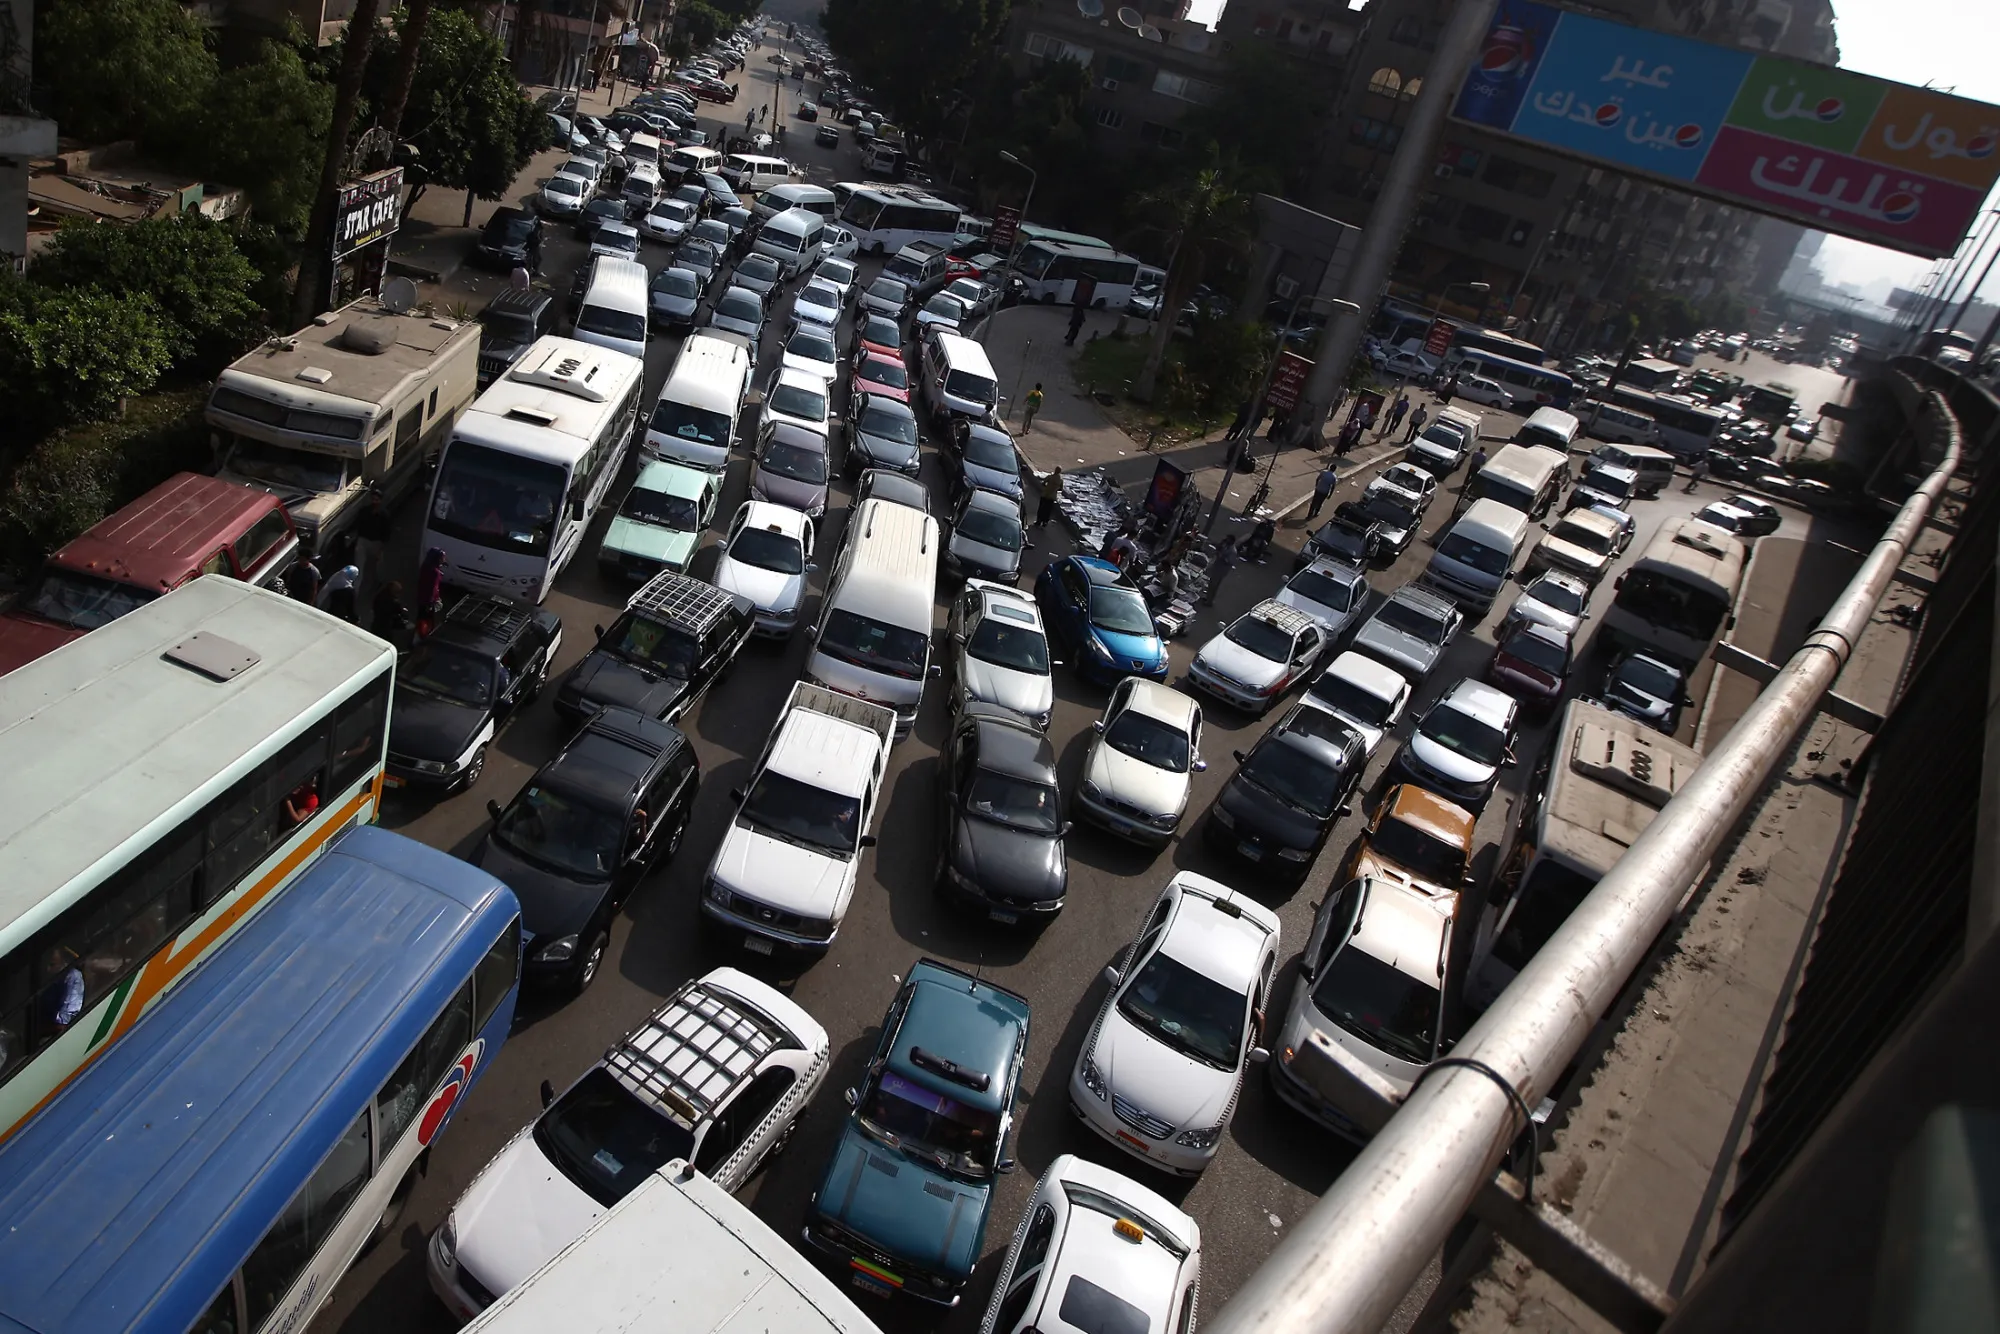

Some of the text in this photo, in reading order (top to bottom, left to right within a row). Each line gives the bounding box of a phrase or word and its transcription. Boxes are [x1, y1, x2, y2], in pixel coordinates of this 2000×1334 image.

[1599, 55, 1674, 88] عبر
[1533, 91, 1703, 151] مين قدك
[1762, 78, 1999, 159] قول من
[344, 205, 370, 240] STAR
[372, 194, 395, 227] CAFE
[1751, 156, 1925, 224] قلبك
